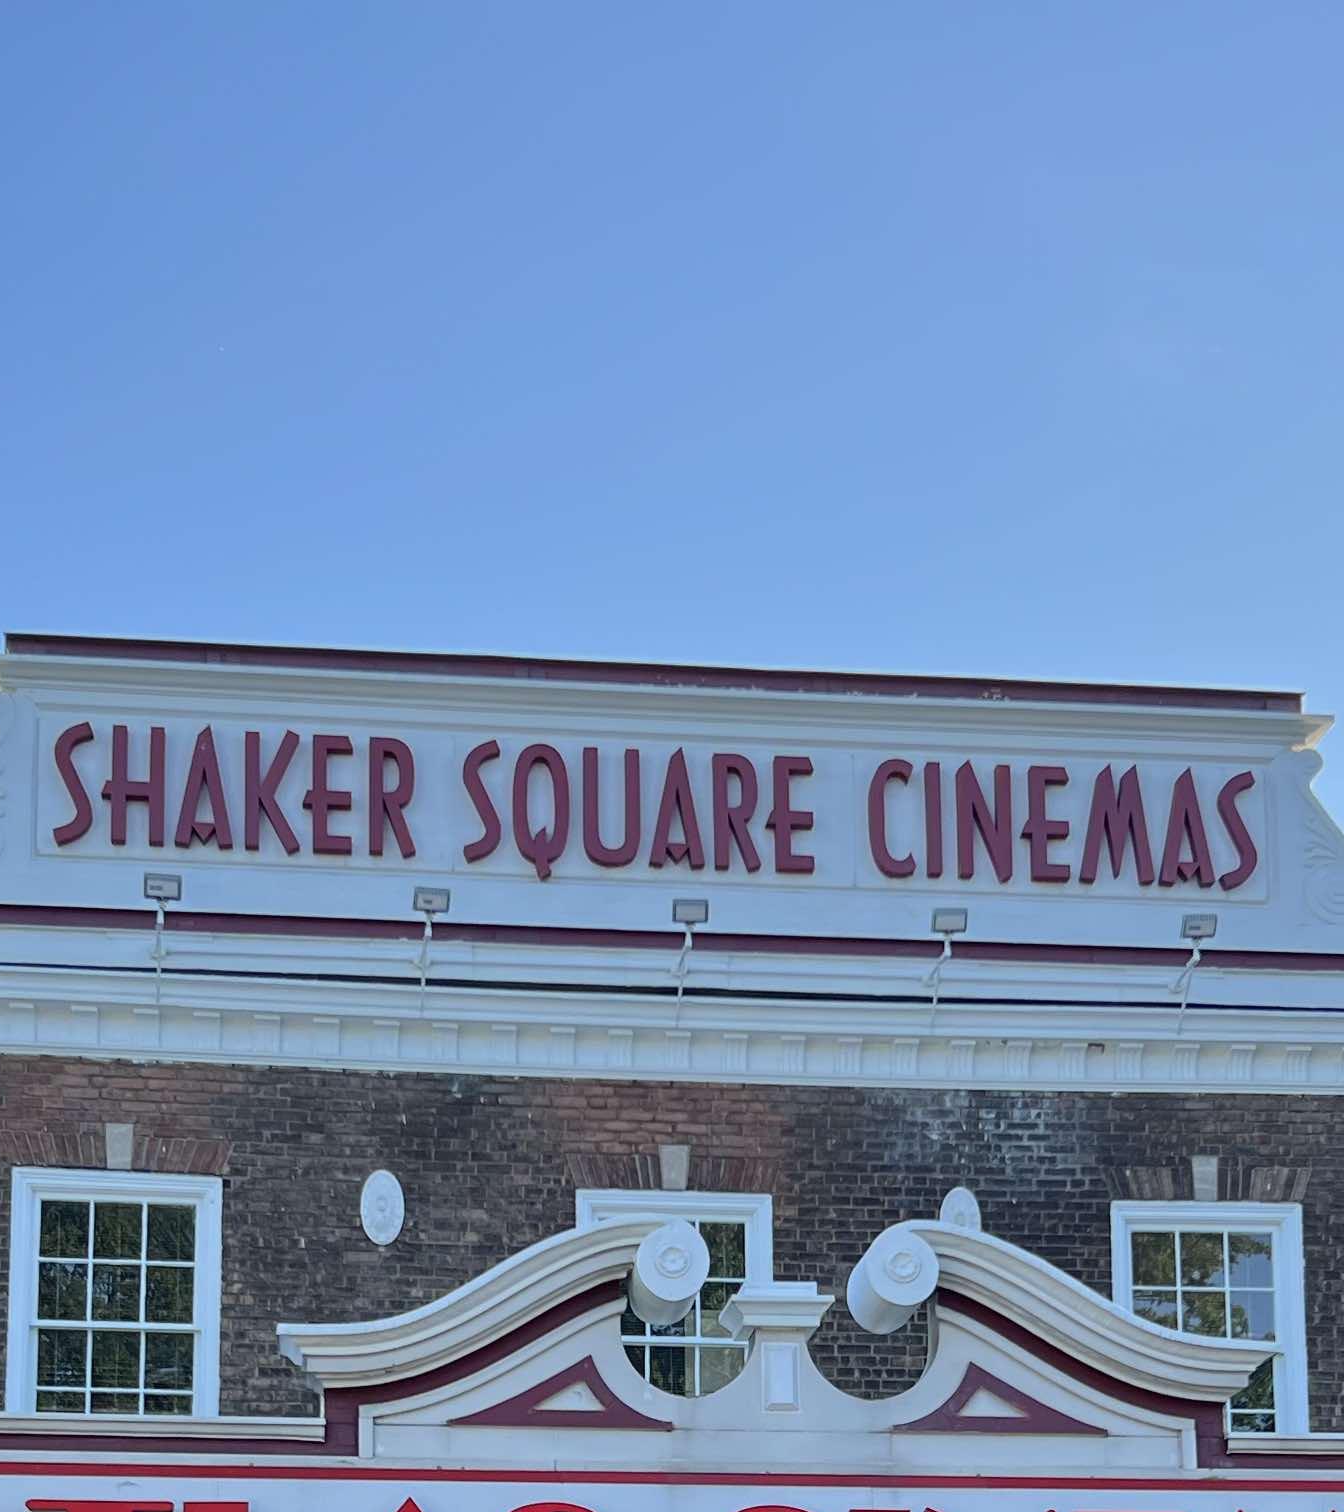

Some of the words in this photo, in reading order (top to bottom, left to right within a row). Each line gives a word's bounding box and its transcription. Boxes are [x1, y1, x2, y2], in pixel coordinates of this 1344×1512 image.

[53, 721, 417, 859] SHAKER
[462, 739, 816, 881] SQUARE
[867, 758, 1258, 892] CINEMAS
